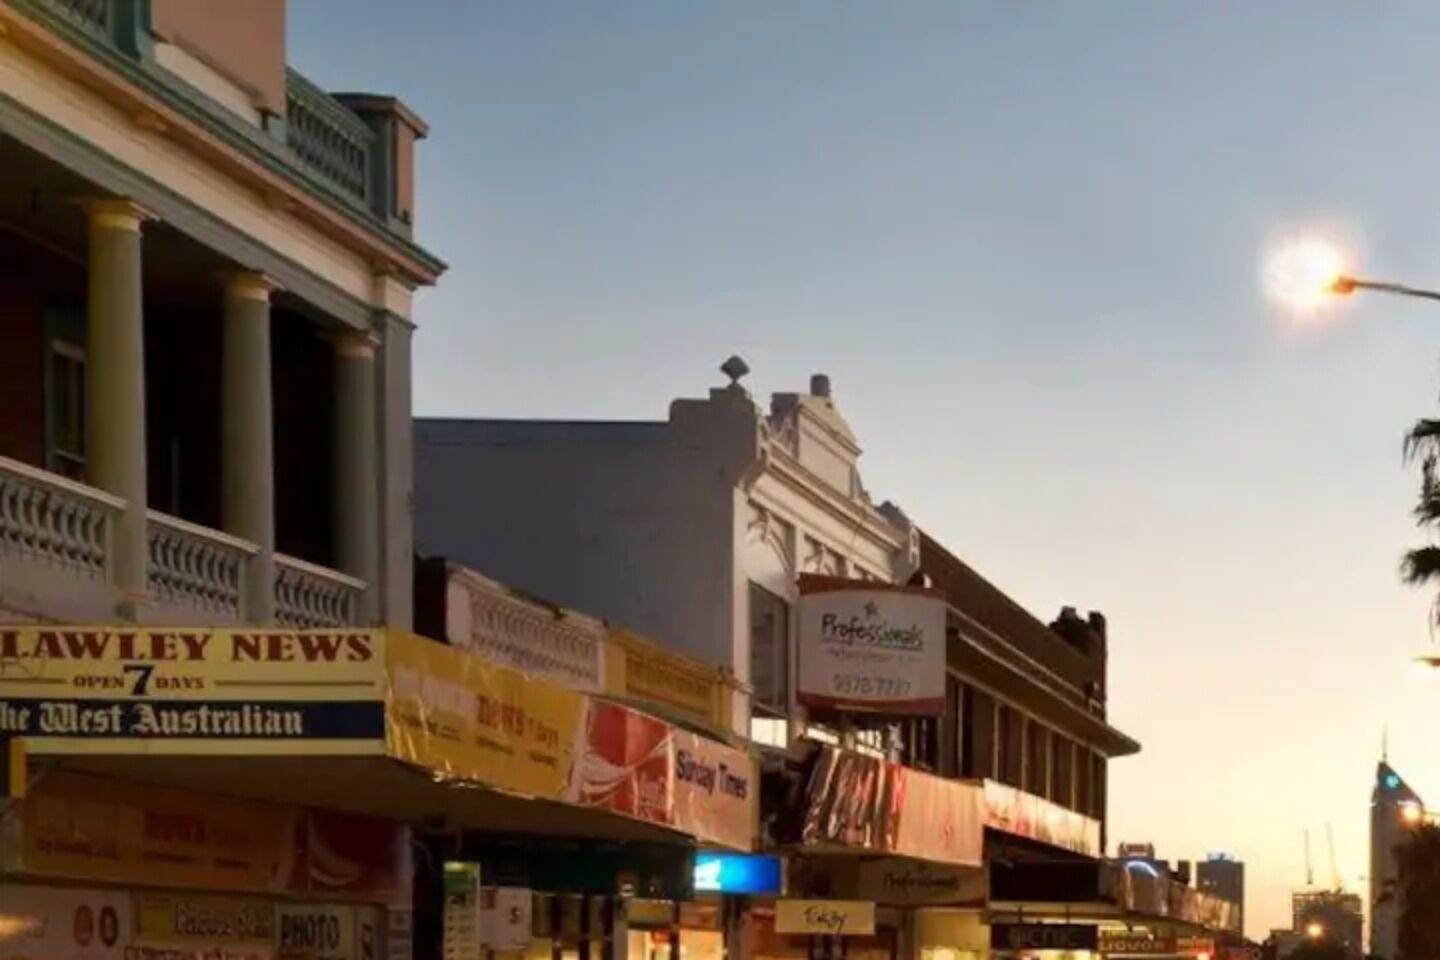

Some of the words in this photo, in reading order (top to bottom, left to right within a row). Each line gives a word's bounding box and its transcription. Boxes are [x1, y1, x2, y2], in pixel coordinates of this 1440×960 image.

[821, 612, 924, 646] Professionals
[0, 631, 213, 661] LAWLEY
[231, 634, 373, 662] NEWS
[73, 675, 125, 689] OPEN
[123, 664, 156, 695] 7
[155, 676, 205, 689] DAYS
[39, 702, 123, 733] West
[130, 702, 304, 737] Australian
